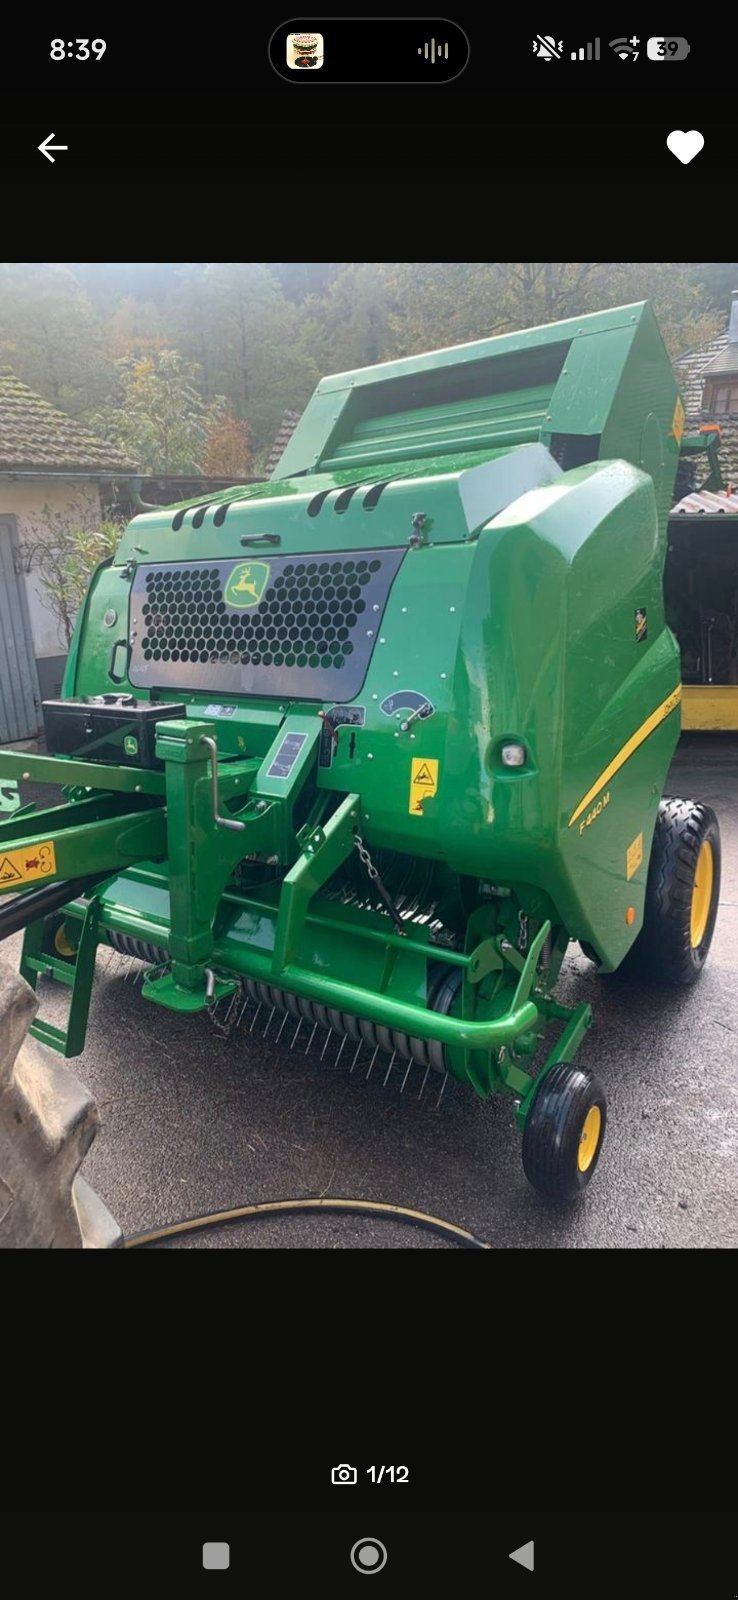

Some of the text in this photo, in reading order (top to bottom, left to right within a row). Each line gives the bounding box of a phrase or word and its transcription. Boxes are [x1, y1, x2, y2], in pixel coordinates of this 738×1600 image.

[50, 38, 107, 61] 8:39
[656, 41, 679, 57] 39
[366, 1465, 409, 1484] 1/12
